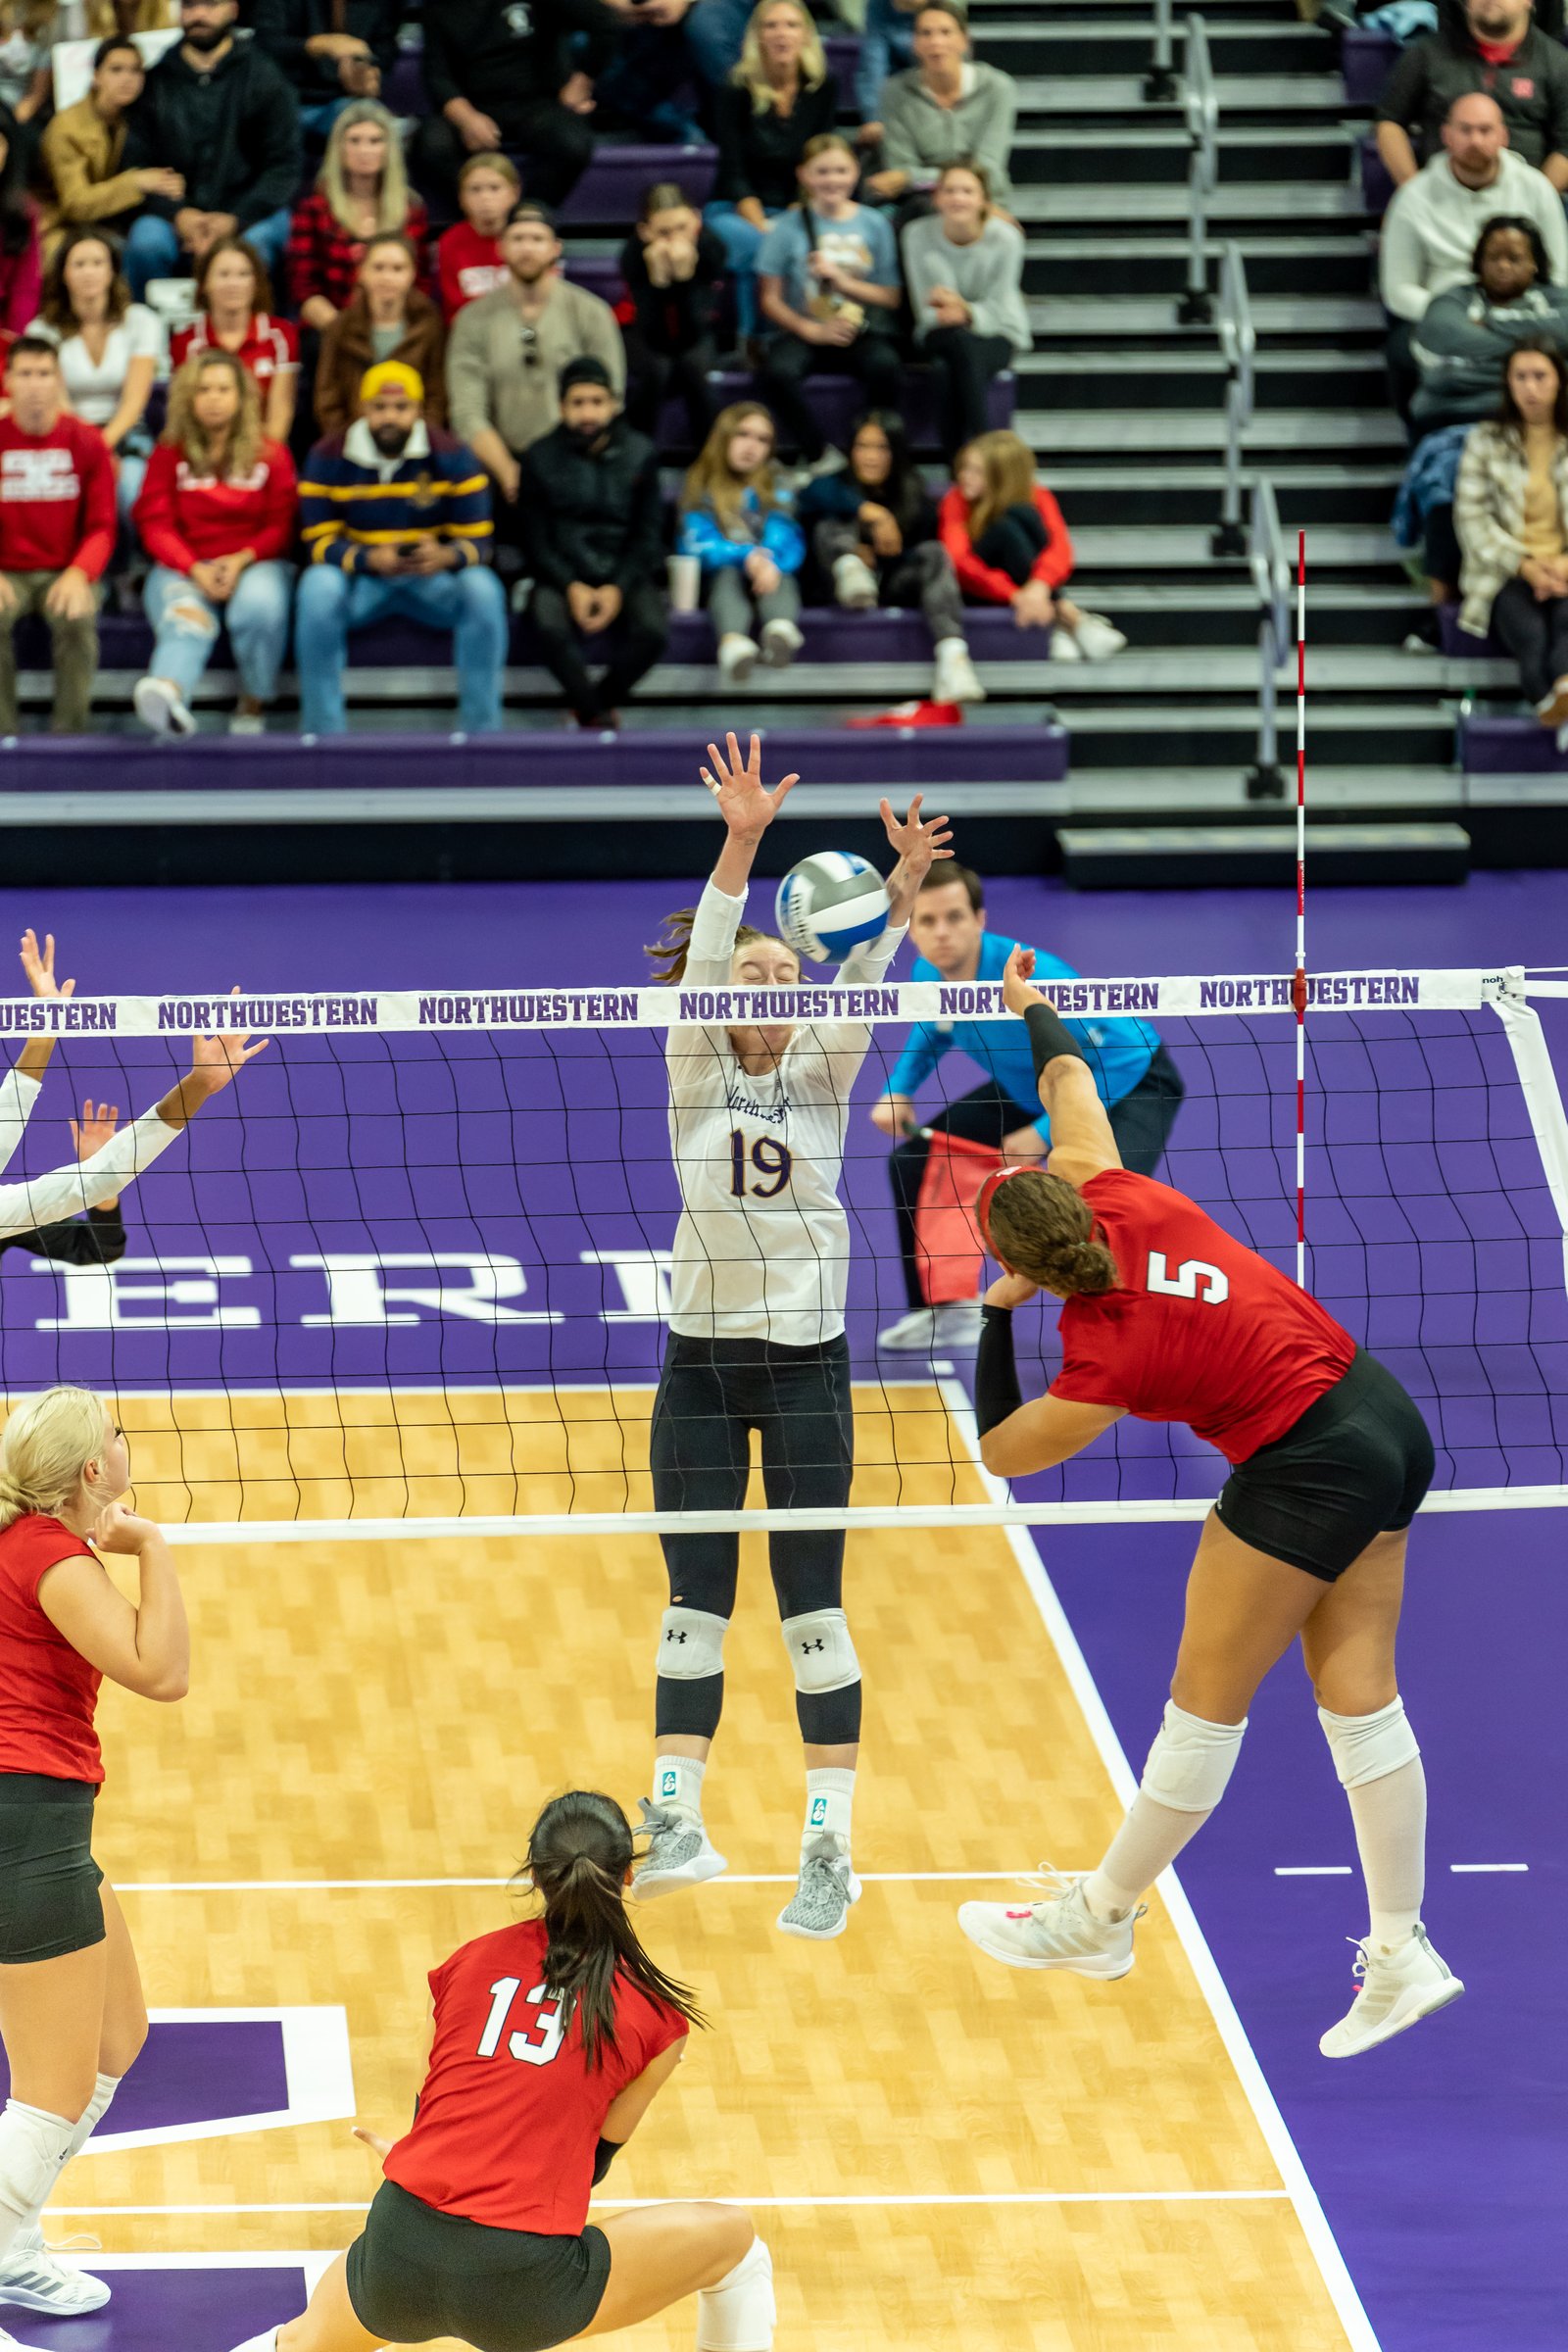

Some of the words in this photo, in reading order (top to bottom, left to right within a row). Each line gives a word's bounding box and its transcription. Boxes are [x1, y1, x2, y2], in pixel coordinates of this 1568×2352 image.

[158, 998, 378, 1029] NORTHWESTERN
[418, 993, 639, 1024] NORTHWESTERN
[679, 989, 900, 1020] NORTHWESTERN
[939, 983, 1159, 1015] NORTESTERN
[730, 1127, 793, 1199] 19
[1146, 1250, 1229, 1305] 5
[475, 1976, 577, 2068] 13
